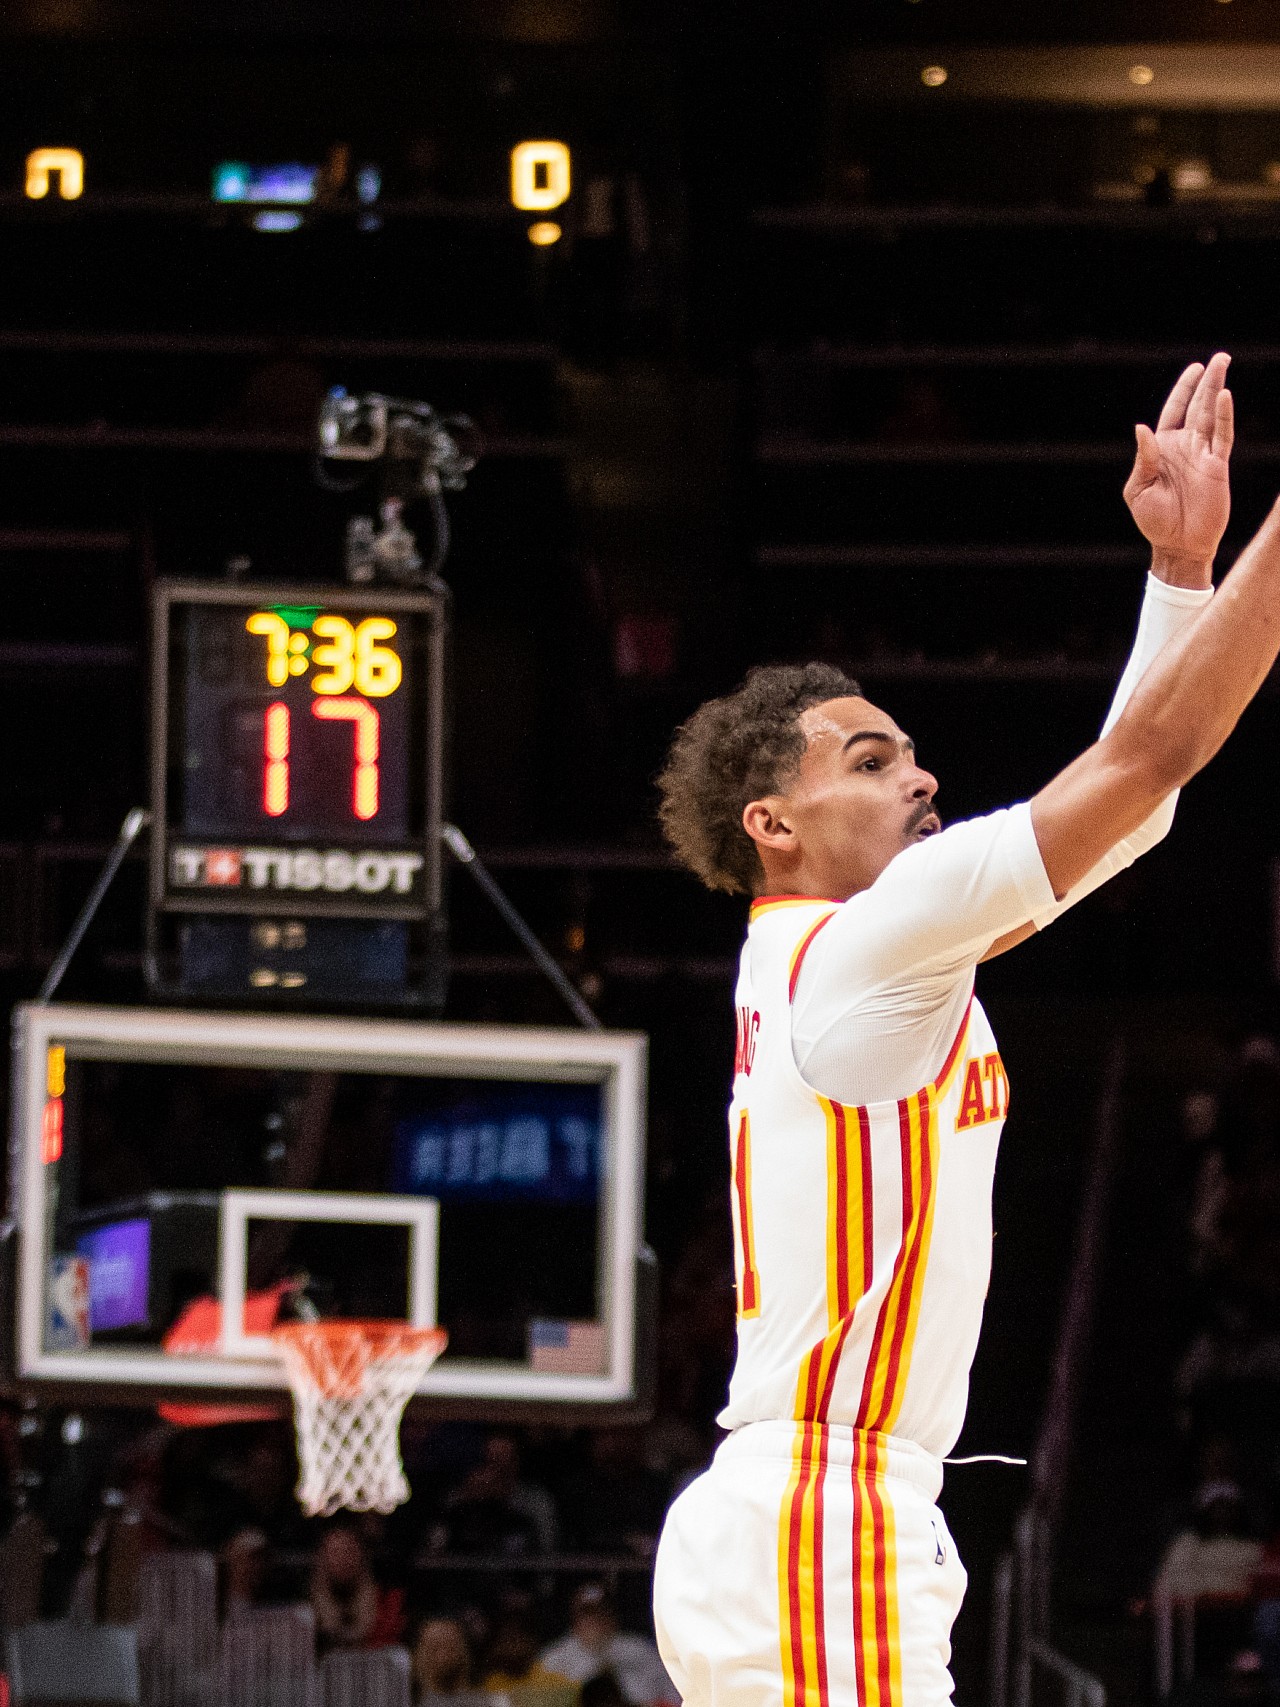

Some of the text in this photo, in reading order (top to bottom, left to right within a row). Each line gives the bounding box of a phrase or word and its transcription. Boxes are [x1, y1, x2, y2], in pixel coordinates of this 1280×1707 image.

[246, 612, 402, 697] 7:36
[264, 697, 380, 820] 17
[242, 849, 424, 893] TISSOT
[955, 1051, 1010, 1134] AT
